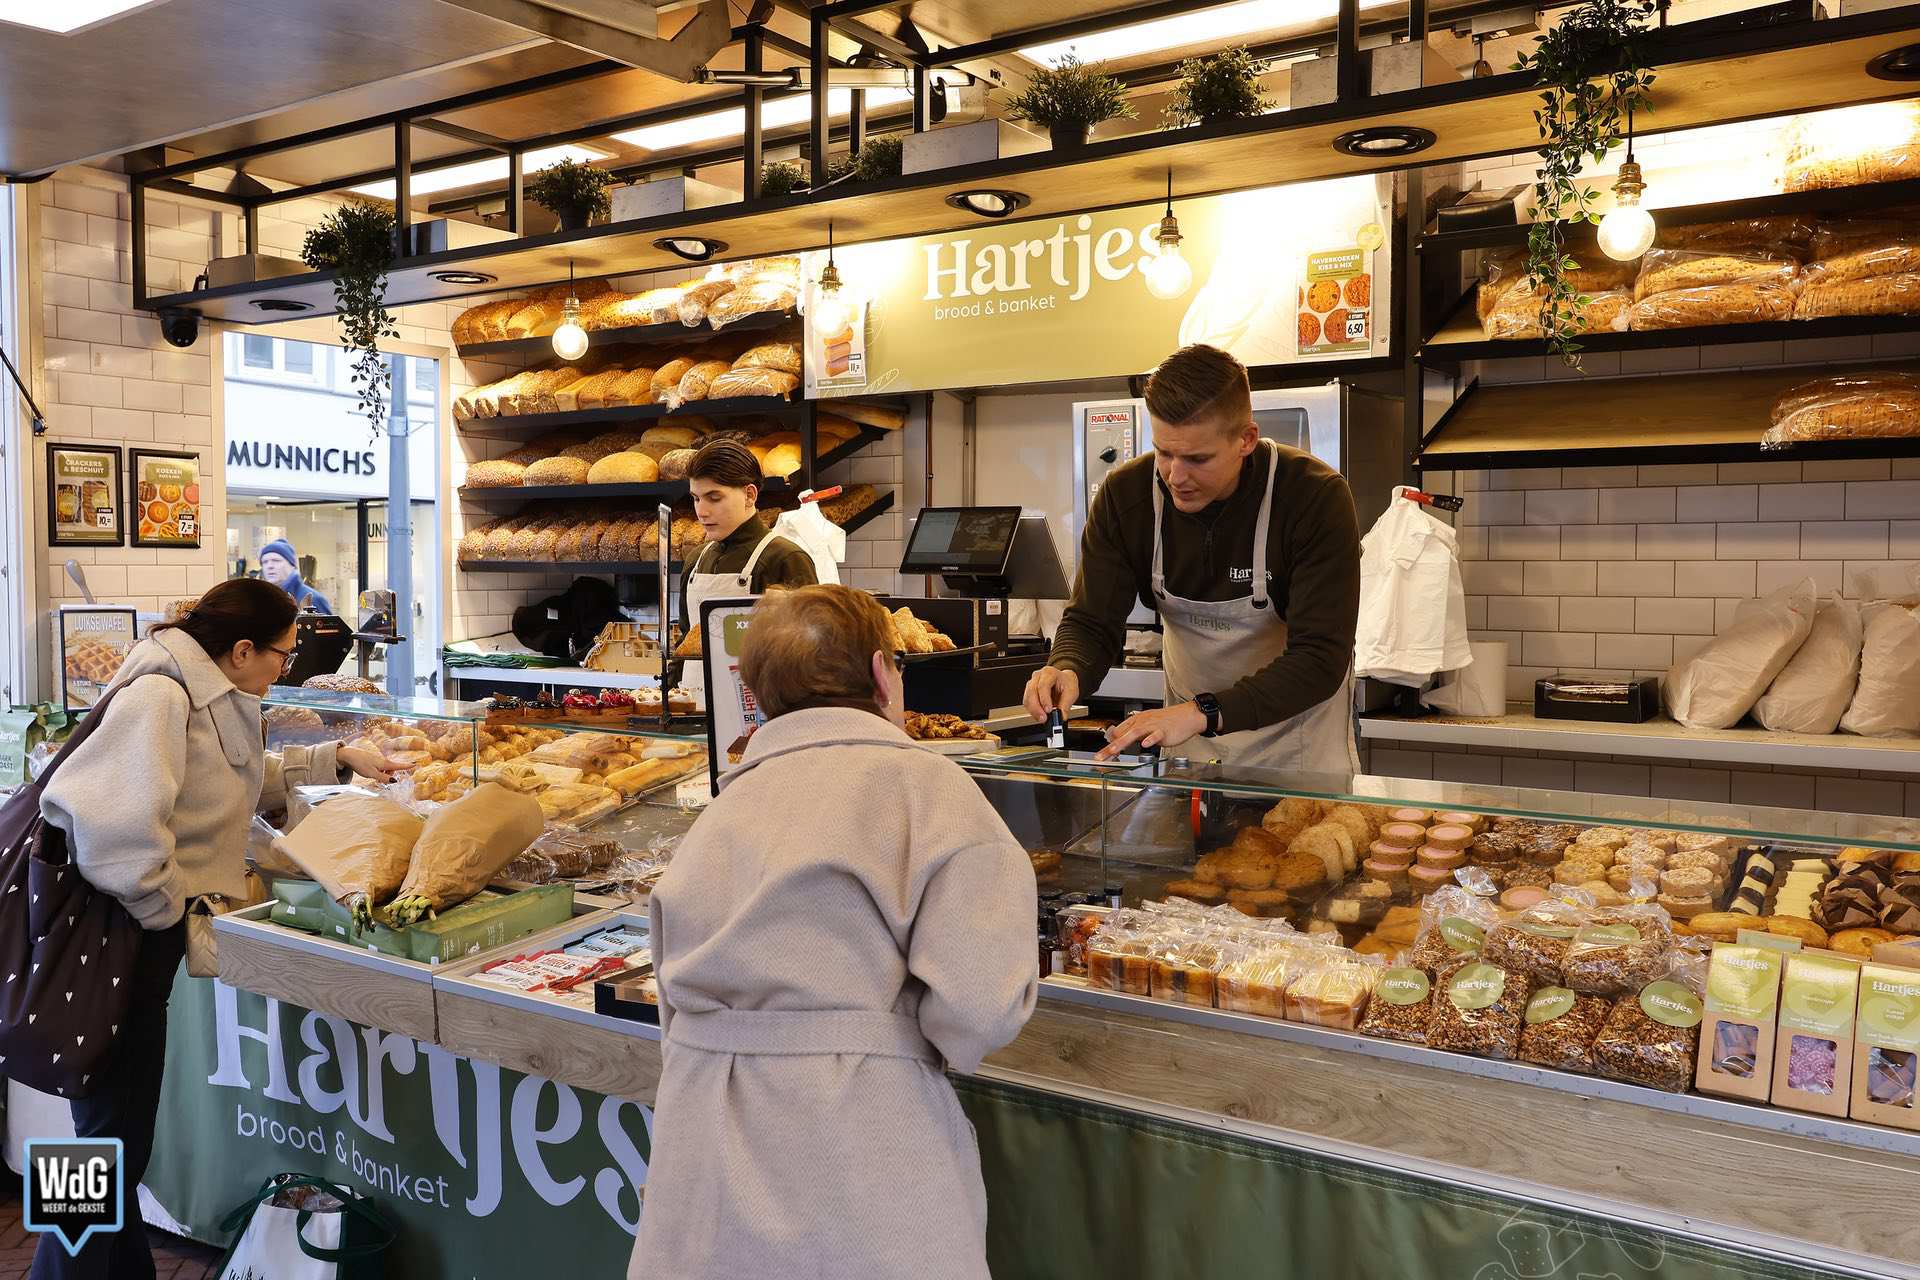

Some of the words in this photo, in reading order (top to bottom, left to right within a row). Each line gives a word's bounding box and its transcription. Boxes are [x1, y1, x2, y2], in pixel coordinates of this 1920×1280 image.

[935, 302, 980, 320] brood
[985, 299, 995, 315] &
[999, 295, 1056, 313] banket
[1347, 323, 1363, 336] 6,50
[1091, 414, 1129, 424] RATIONAL
[65, 459, 102, 467] CRACKERS
[227, 440, 376, 476] MUNNICHS
[70, 466, 105, 474] BESCHUIT
[74, 615, 101, 631] LUIKSE
[101, 616, 127, 632] WAFEL
[1447, 927, 1481, 946] Hartjes
[1385, 979, 1421, 991] Hartjes
[1456, 979, 1496, 991] Hartjes
[1530, 995, 1565, 1009] Hartjes
[1650, 995, 1693, 1015] Hartjes
[207, 976, 656, 1238] Hartjes
[237, 1103, 326, 1156] brood
[335, 1130, 348, 1166] &
[352, 1139, 450, 1209] banket
